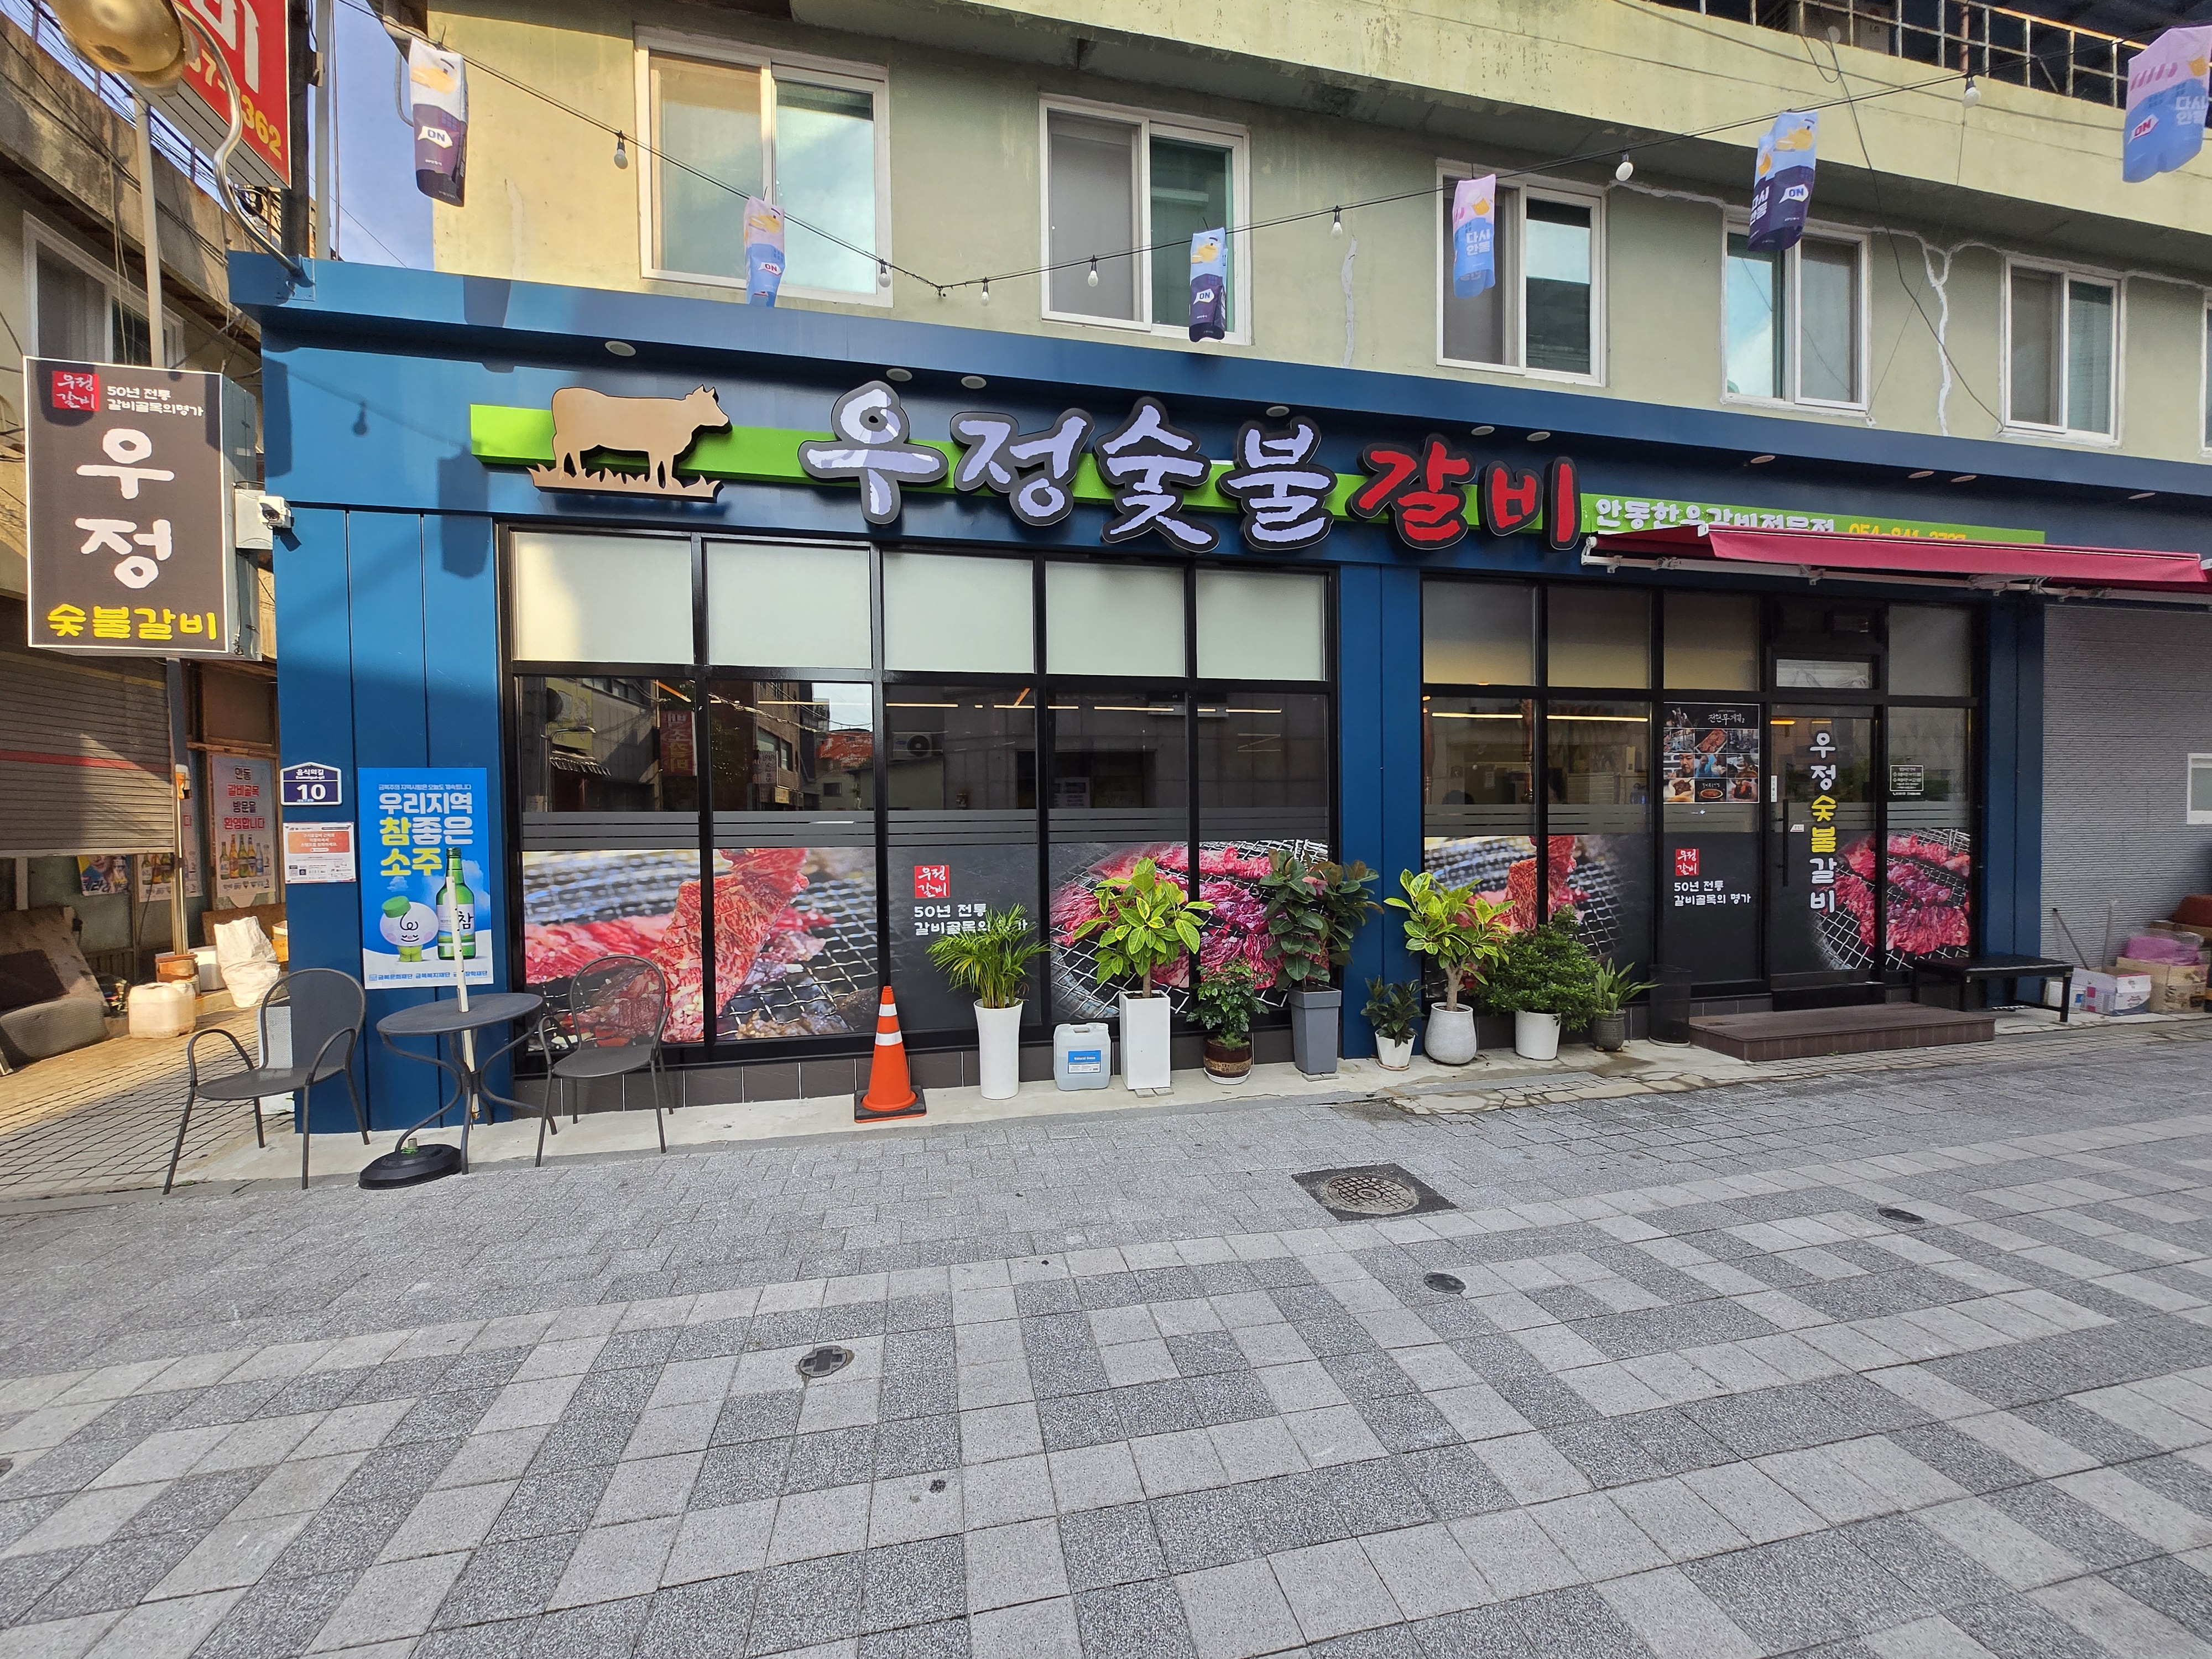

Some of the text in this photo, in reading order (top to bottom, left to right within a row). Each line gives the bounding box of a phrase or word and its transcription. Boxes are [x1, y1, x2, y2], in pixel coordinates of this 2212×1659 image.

[2135, 119, 2152, 136] ON
[427, 129, 445, 142] ON
[1788, 188, 1804, 197] ON
[1466, 229, 1490, 243] 다시
[1466, 241, 1490, 256] 안동
[765, 263, 778, 272] ON
[57, 374, 95, 392] 우정
[56, 391, 95, 409] 갈비
[107, 386, 171, 401] 50년 전통
[107, 399, 204, 416] 갈비골목의명가
[801, 383, 1580, 551] 우정숯불갈비
[75, 429, 175, 588] 우정
[48, 603, 217, 640] 숯불갈비
[234, 767, 252, 781] 안동
[227, 784, 259, 797] 갈비골목
[296, 784, 326, 800] 10
[233, 801, 256, 813] 방문을
[379, 792, 473, 815] 우리지역
[224, 817, 265, 830] 환영합니다
[1810, 733, 1837, 913] 우정숯불갈비
[380, 816, 473, 846] 참좋은
[380, 848, 442, 877] 소주
[1677, 849, 1697, 862] 우정
[918, 865, 946, 880] 우정
[1677, 863, 1697, 875] 갈비
[917, 882, 947, 898] 갈비
[1674, 880, 1724, 892] 50년 전통
[1674, 894, 1751, 906] 갈비골목의 명가
[914, 904, 987, 918] 50년 전통
[458, 910, 474, 930] 참
